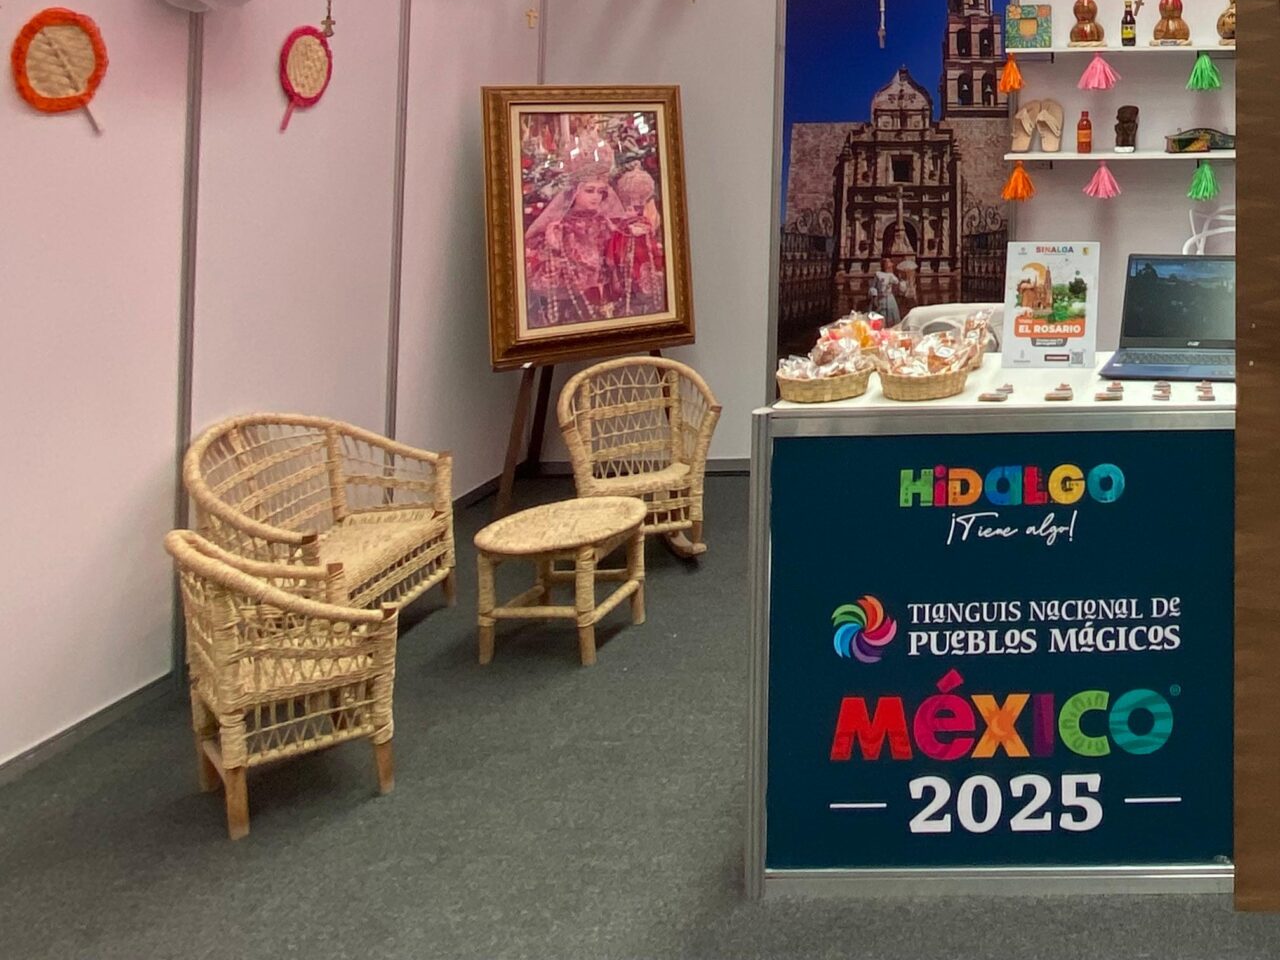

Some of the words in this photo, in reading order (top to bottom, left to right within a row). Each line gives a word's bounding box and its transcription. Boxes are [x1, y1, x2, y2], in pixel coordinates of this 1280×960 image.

[1018, 324, 1032, 334] EL
[1034, 324, 1082, 334] ROSARIO
[1026, 510, 1078, 546] algo!
[908, 773, 1104, 833] 2025
